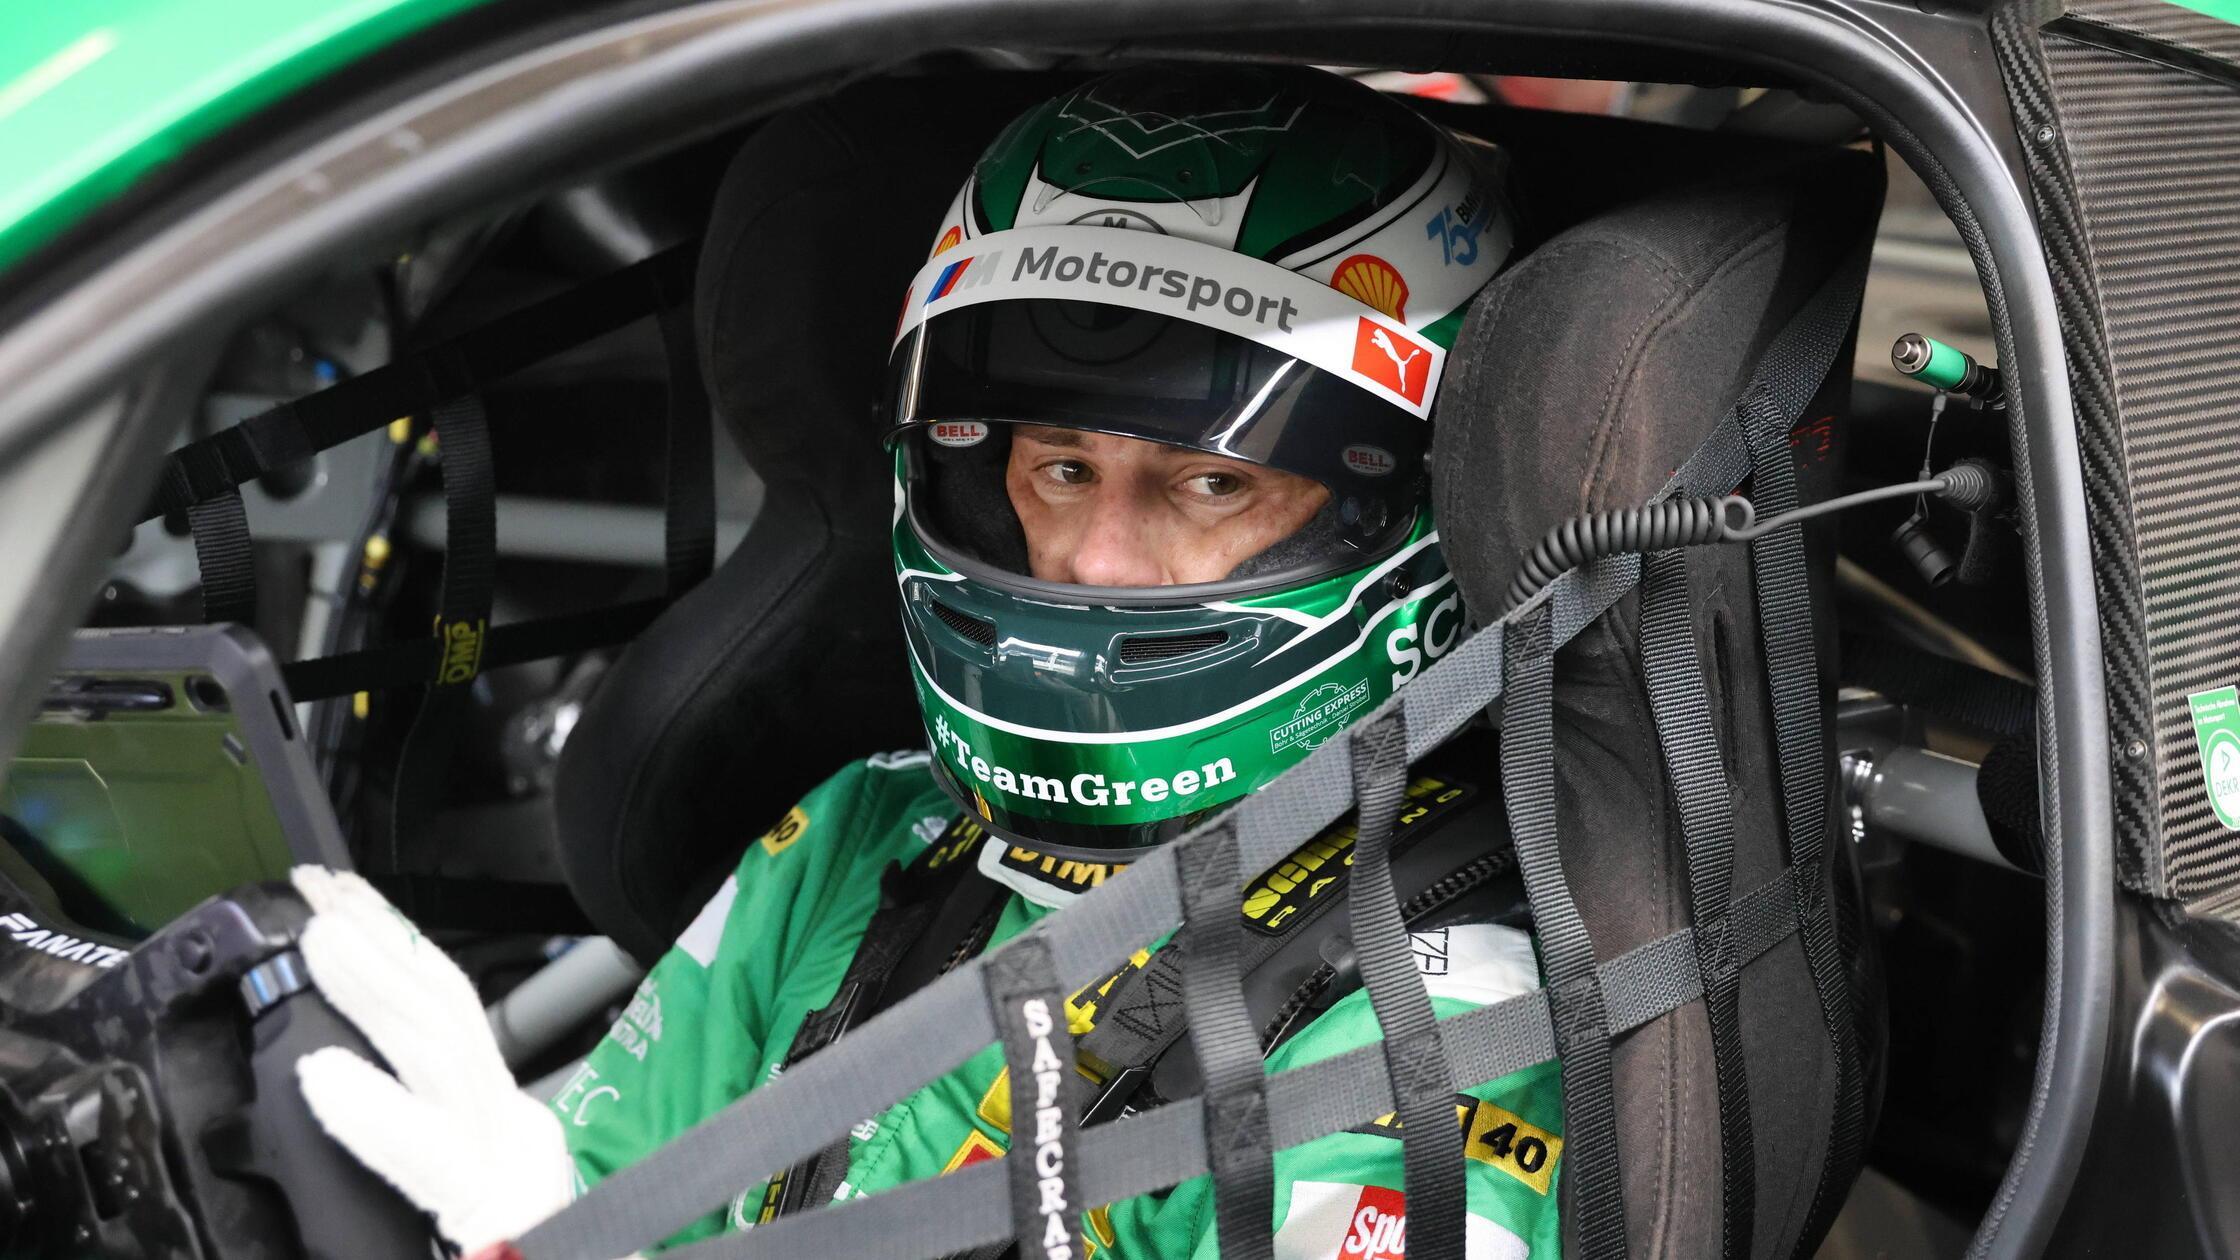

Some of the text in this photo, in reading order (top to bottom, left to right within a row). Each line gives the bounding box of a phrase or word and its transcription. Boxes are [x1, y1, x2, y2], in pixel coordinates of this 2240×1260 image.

[1011, 246, 1299, 334] Motorsport
[936, 425, 981, 438] BELL
[1348, 449, 1391, 468] BELL
[446, 622, 477, 683] OMP
[1273, 682, 1367, 741] CUTTING EXPRESS
[935, 713, 1237, 807] #TeamGreen
[1479, 1122, 1548, 1174] 40
